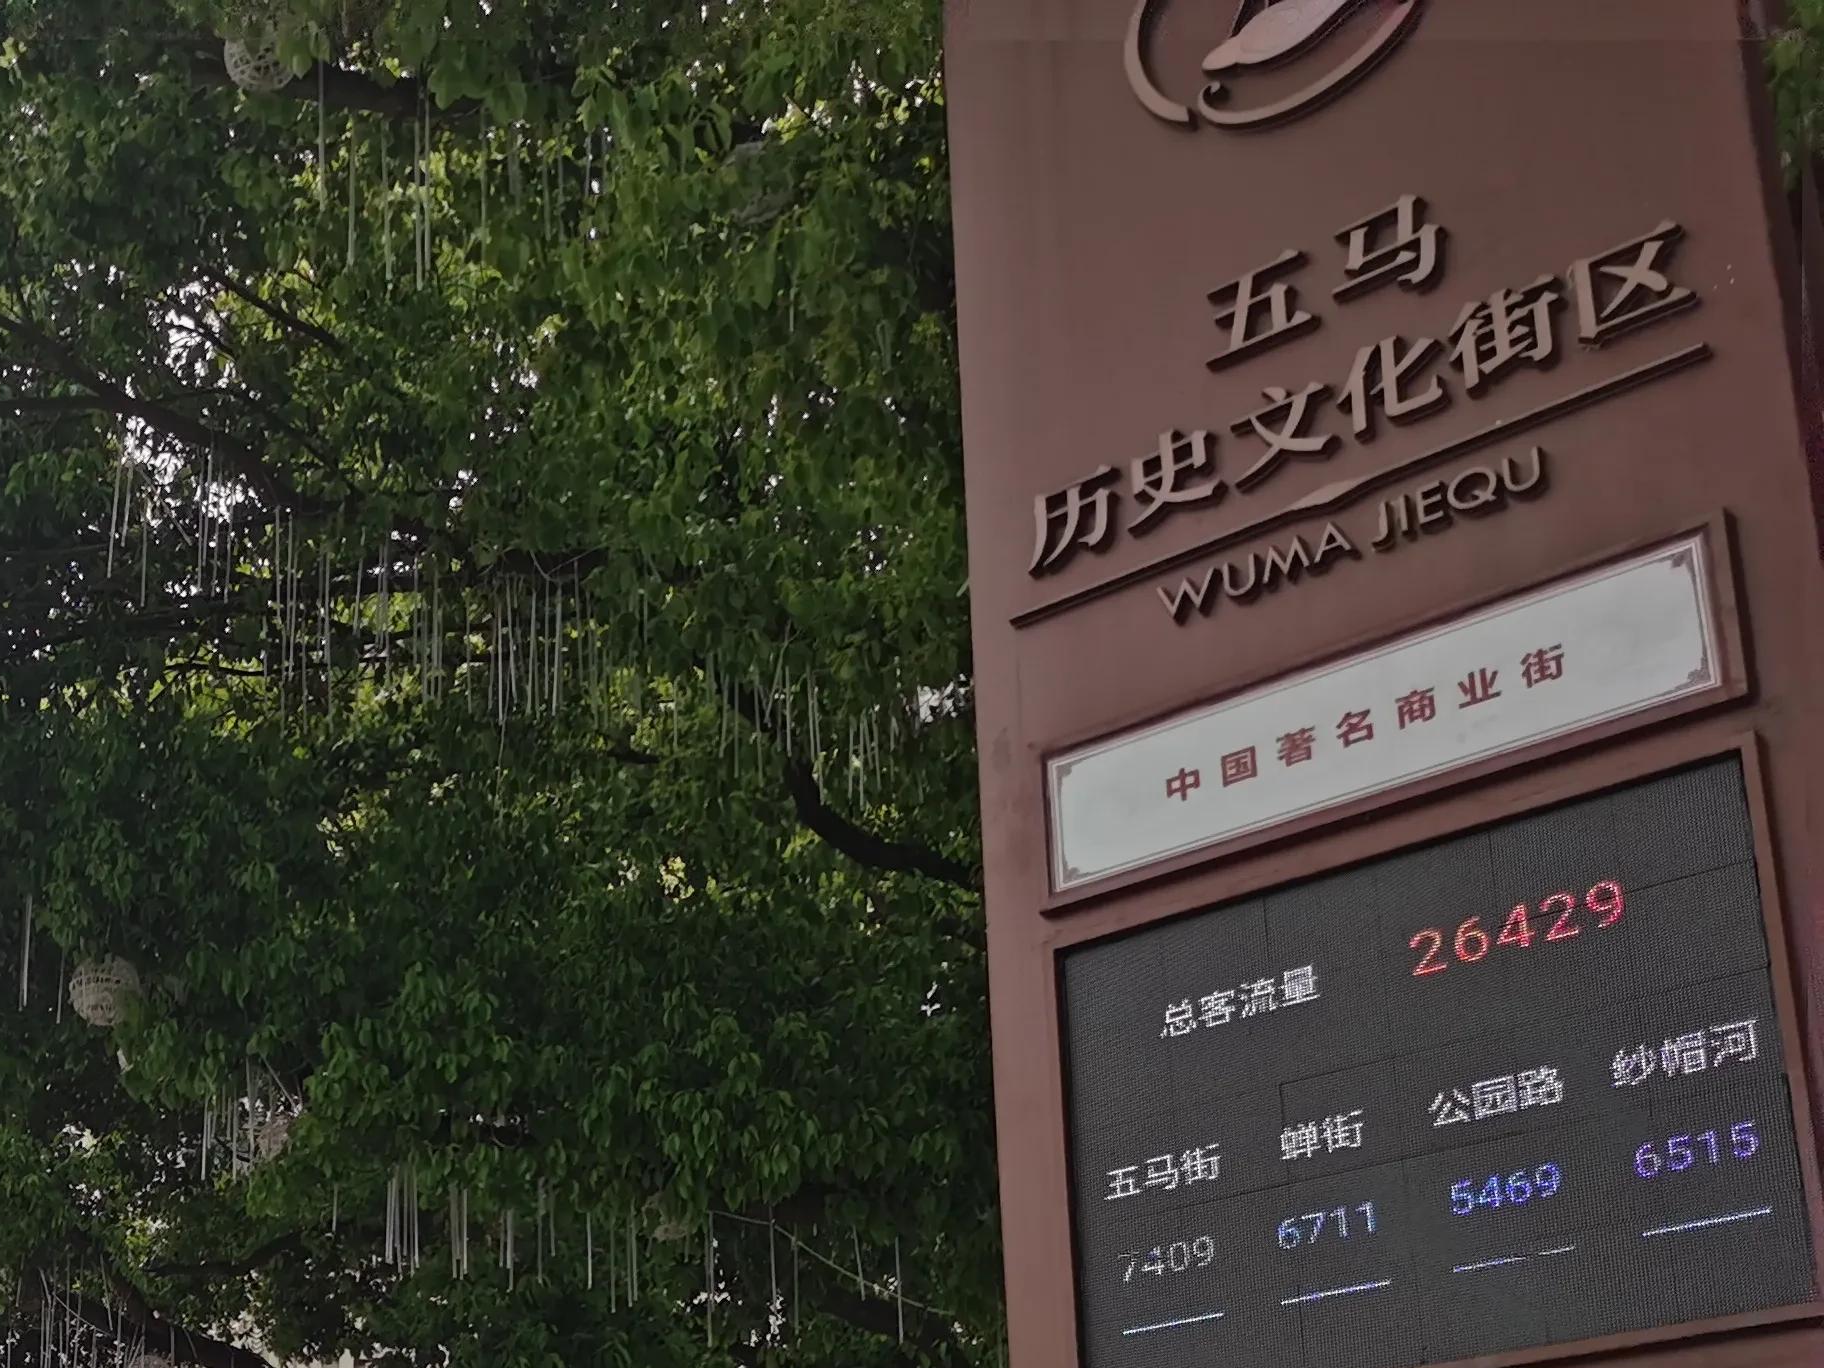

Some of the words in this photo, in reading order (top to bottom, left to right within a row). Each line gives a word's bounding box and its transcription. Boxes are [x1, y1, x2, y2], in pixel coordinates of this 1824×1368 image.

[1206, 196, 1448, 369] 五马
[1028, 220, 1697, 577] 历史文化街区
[1156, 521, 1360, 624] WUMA
[1370, 446, 1548, 551] JIEQU
[1164, 644, 1566, 803] 中国著名商业街
[1159, 965, 1321, 1040] 总客流量
[1408, 878, 1627, 978] 26429
[1103, 1143, 1222, 1201] 五马街
[1279, 1108, 1366, 1162] 蝉街
[1427, 1065, 1566, 1129] 公园路
[1610, 1017, 1761, 1090] 纱帽河
[1118, 1234, 1217, 1285] 7409
[1277, 1200, 1378, 1251] 6711
[1448, 1160, 1564, 1217] 5469
[1633, 1120, 1762, 1180] 6515
